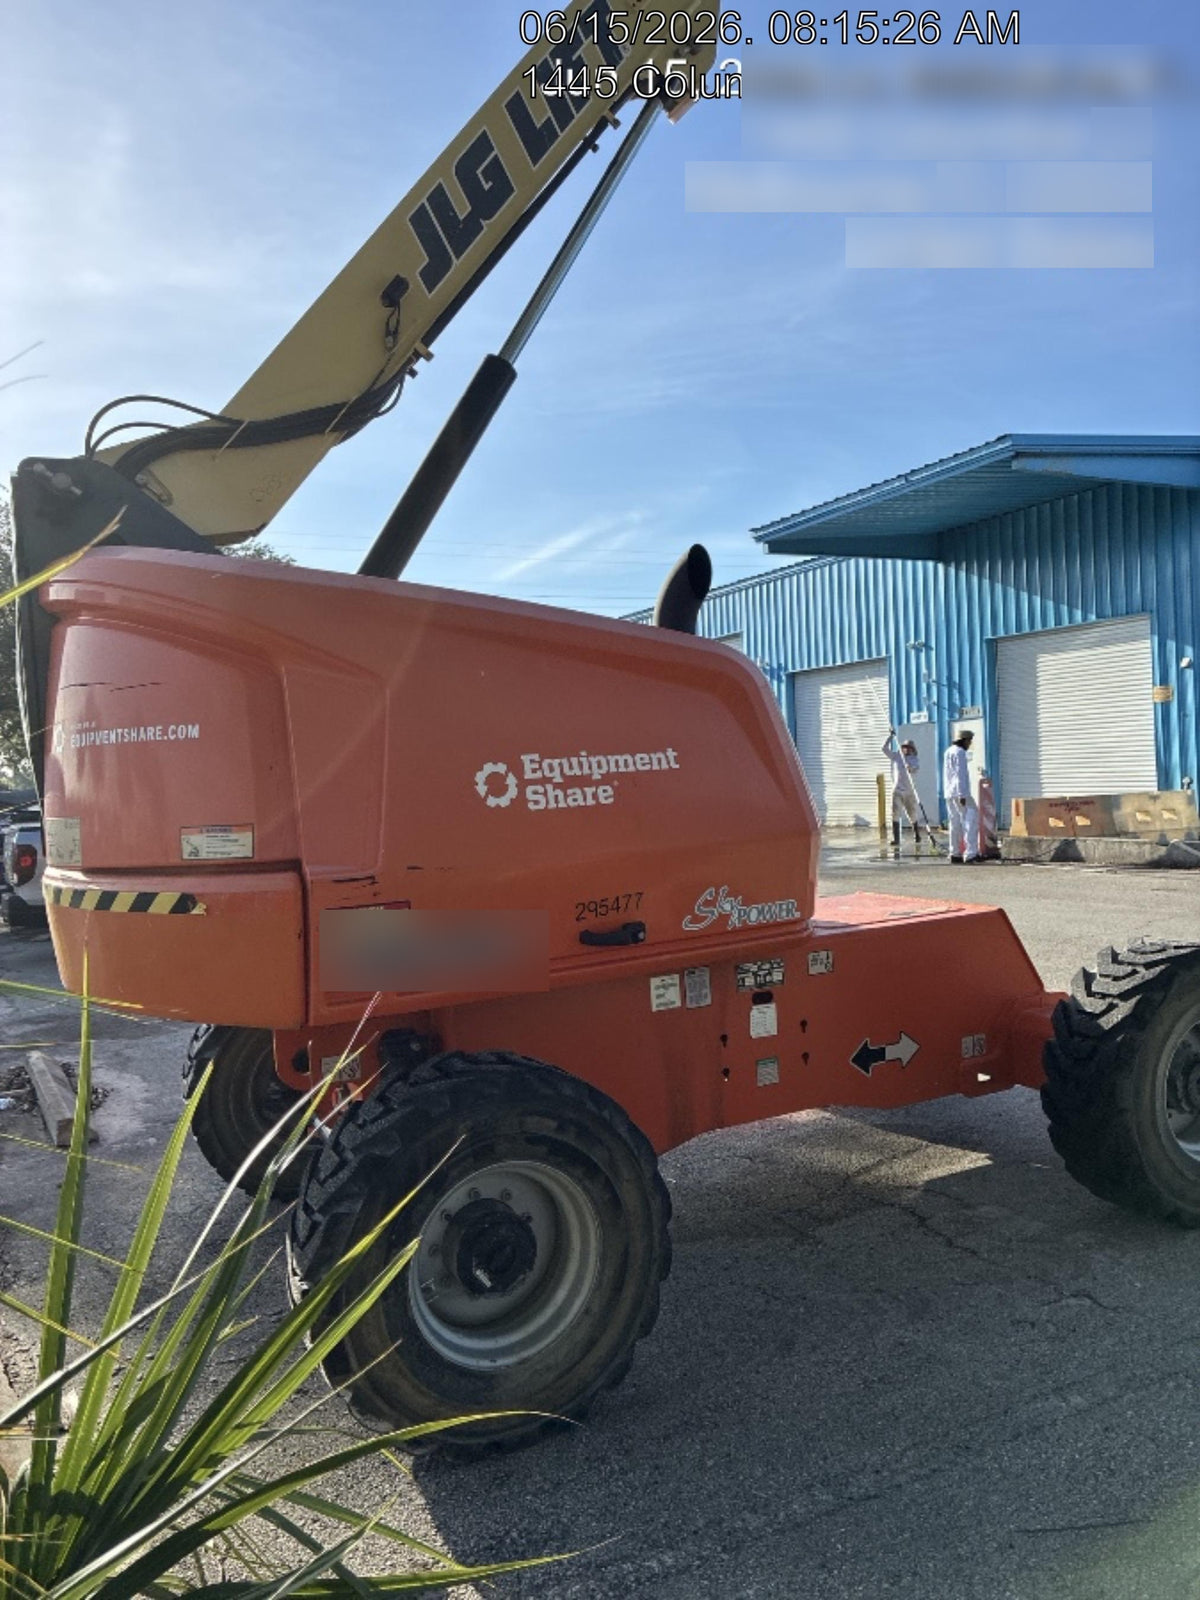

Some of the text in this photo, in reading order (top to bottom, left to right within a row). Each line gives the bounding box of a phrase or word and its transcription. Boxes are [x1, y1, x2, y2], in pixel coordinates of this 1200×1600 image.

[407, 125, 517, 298] JLG
[520, 748, 680, 783] Equipment
[525, 783, 615, 811] Share
[575, 891, 644, 921] 295477
